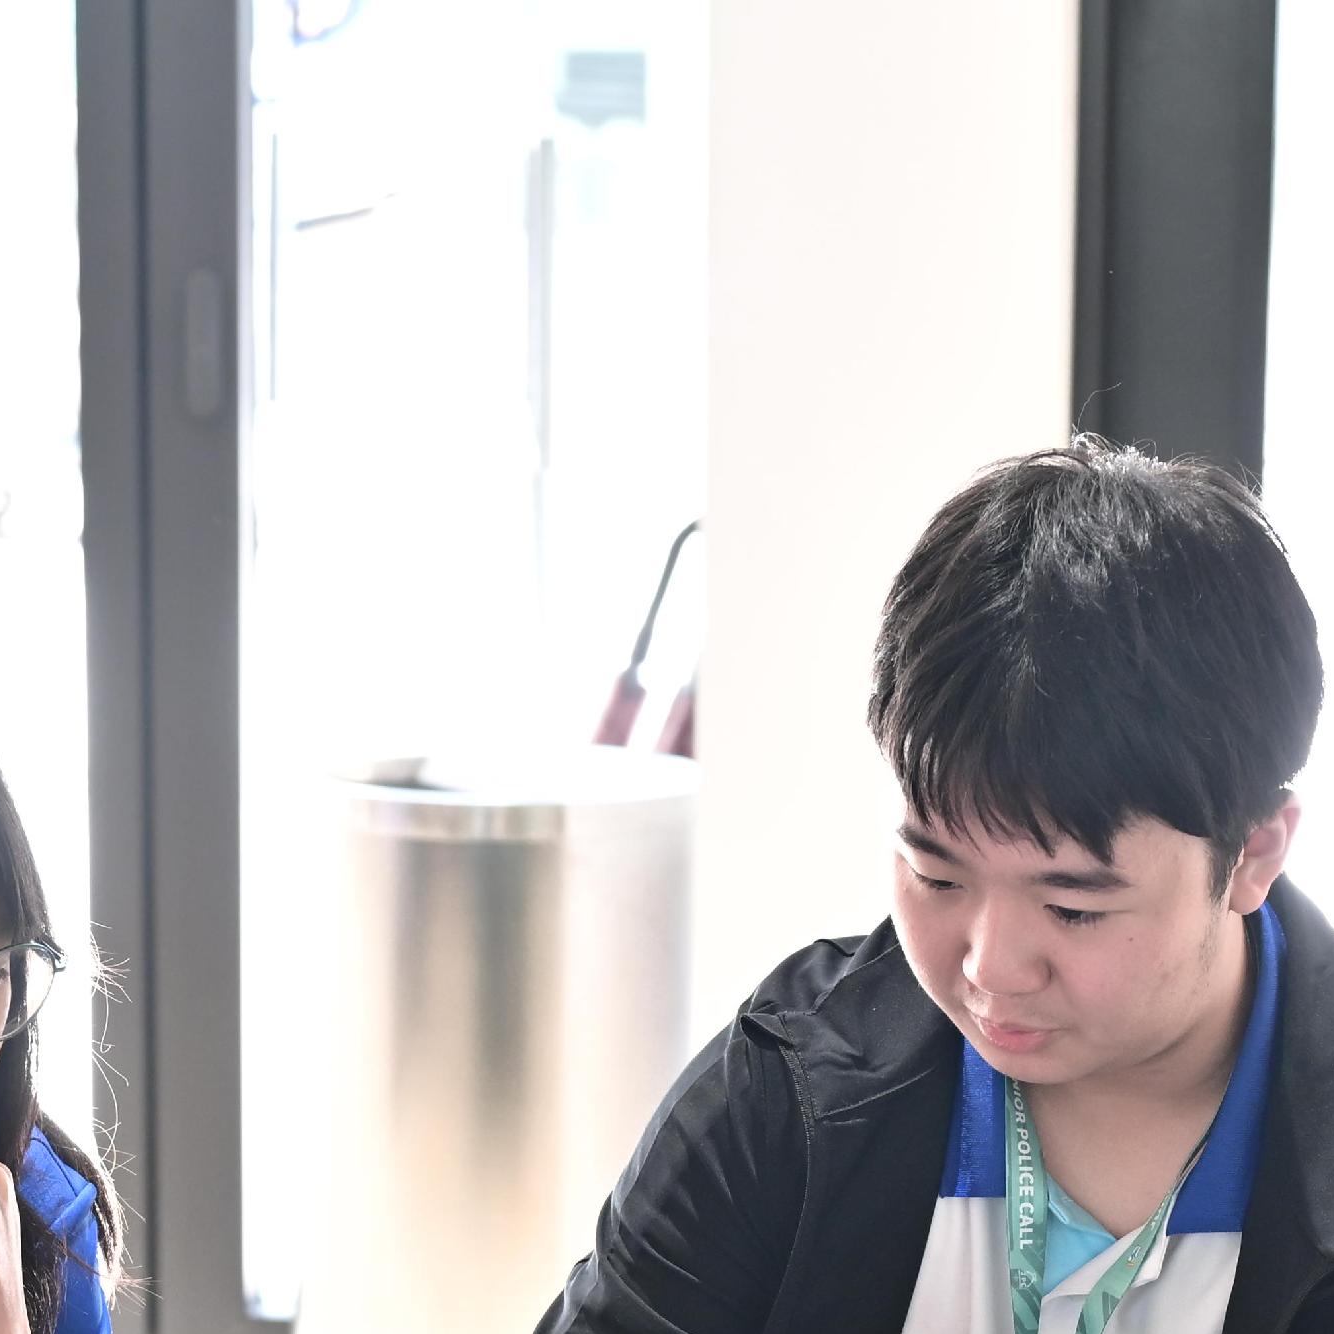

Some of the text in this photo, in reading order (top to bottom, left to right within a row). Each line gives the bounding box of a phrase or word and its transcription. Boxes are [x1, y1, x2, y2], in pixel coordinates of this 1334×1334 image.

[1013, 1080, 1035, 1250] NIOR POLICE CALL
